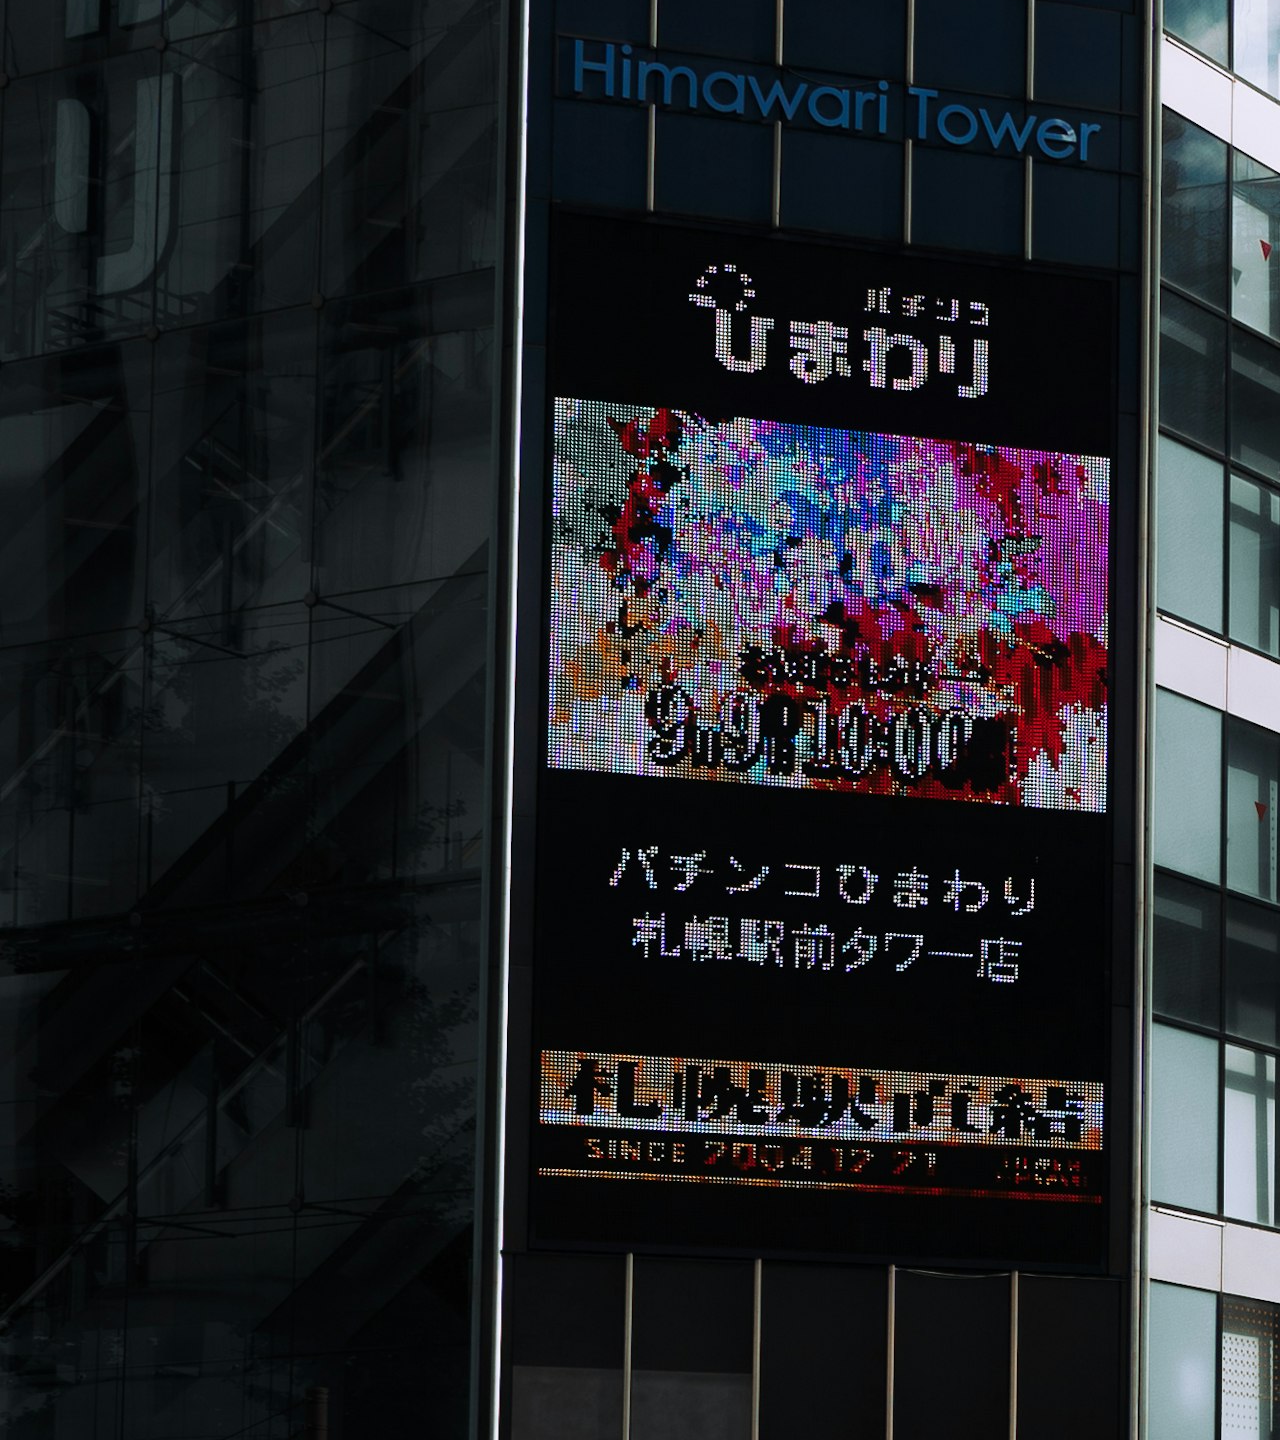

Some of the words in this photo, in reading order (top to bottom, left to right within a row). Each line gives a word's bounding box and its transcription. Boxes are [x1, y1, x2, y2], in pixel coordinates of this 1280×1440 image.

[574, 40, 890, 134] Himawari
[908, 86, 1101, 160] Tower
[689, 293, 990, 399] ひまわり
[608, 845, 1036, 916] パチンコひまわり
[631, 911, 1023, 983] 札幌駅前タワー店
[586, 1137, 687, 1164] SINCE
